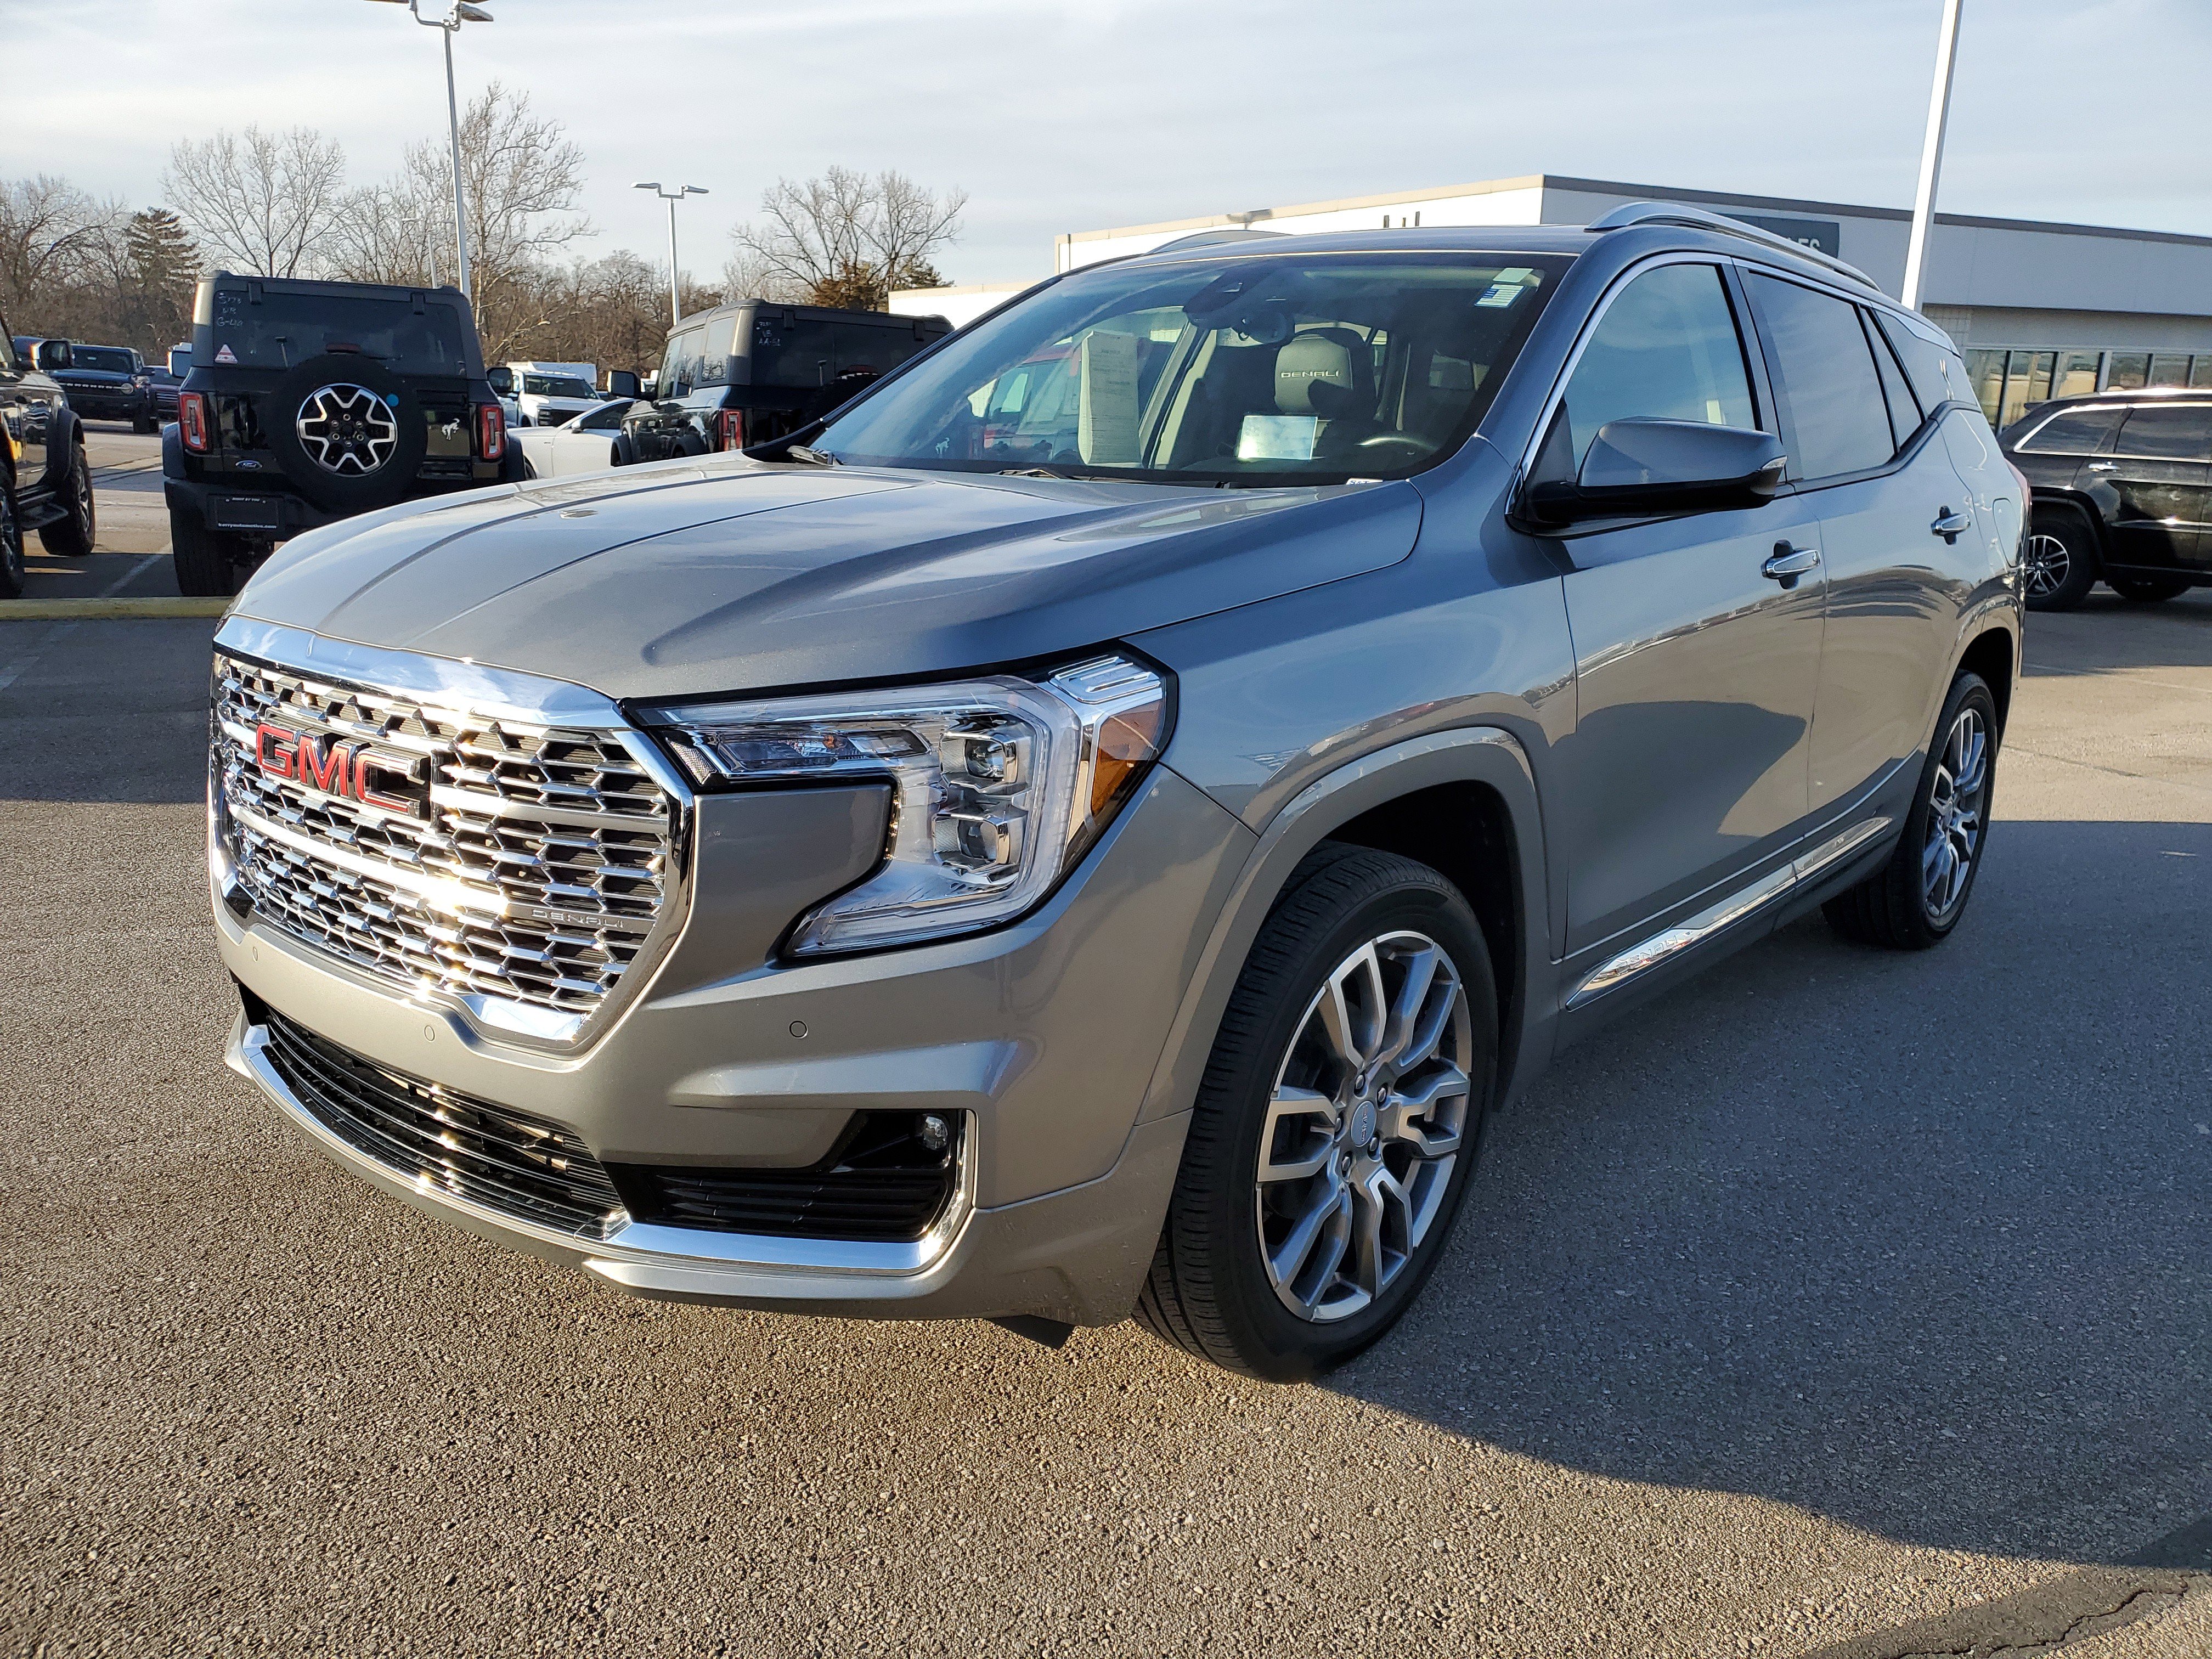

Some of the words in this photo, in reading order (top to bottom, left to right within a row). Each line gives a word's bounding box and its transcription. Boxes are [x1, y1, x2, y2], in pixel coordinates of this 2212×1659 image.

[1281, 370, 1339, 378] DENALI
[256, 719, 424, 820] GMC
[531, 909, 624, 929] DENALI
